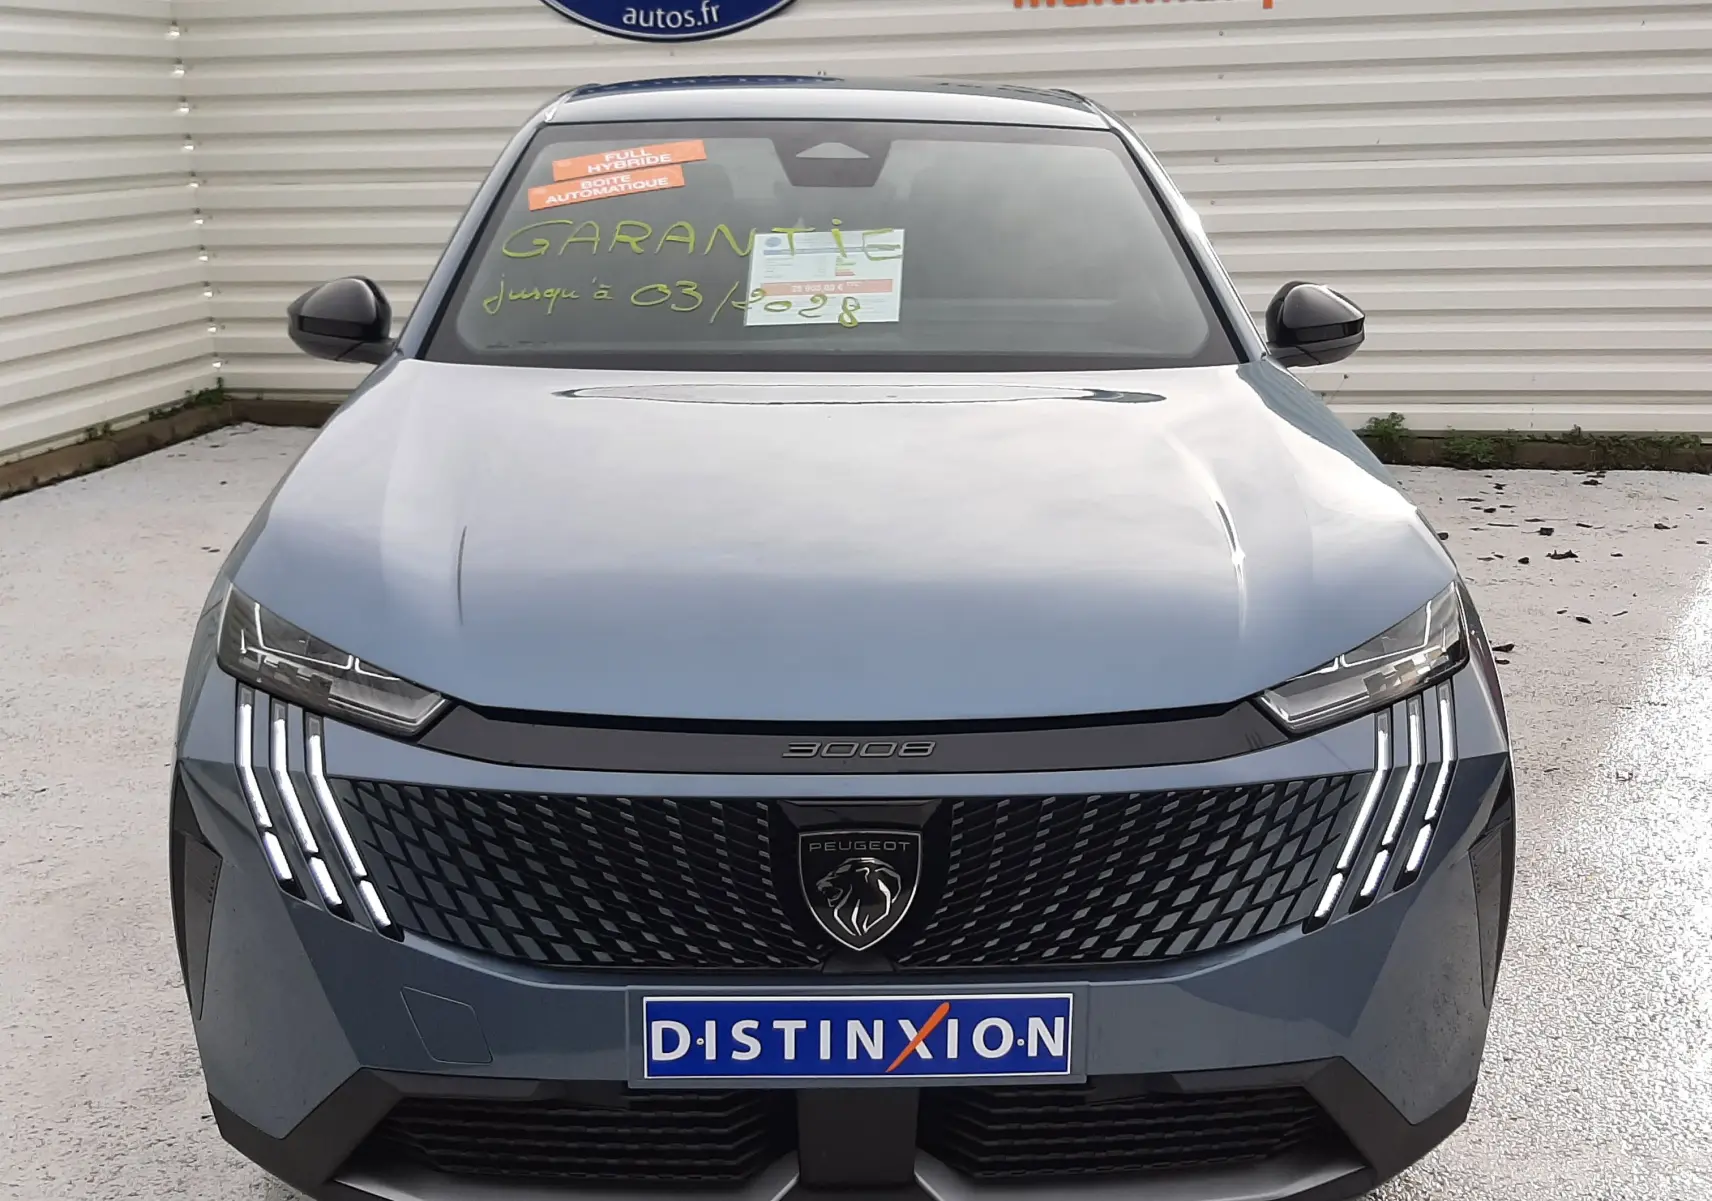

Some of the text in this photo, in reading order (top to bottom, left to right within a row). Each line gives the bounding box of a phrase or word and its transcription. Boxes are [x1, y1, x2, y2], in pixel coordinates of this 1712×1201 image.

[622, 0, 720, 28] autos.fr
[587, 153, 673, 173] HYBRIDE
[604, 148, 653, 162] FULL
[545, 177, 670, 204] AUTOMATIQUE
[580, 174, 632, 190] BOITE
[782, 741, 937, 758] 3008
[809, 841, 911, 852] PEUGEOT
[651, 1002, 1065, 1073] DISTINXION
